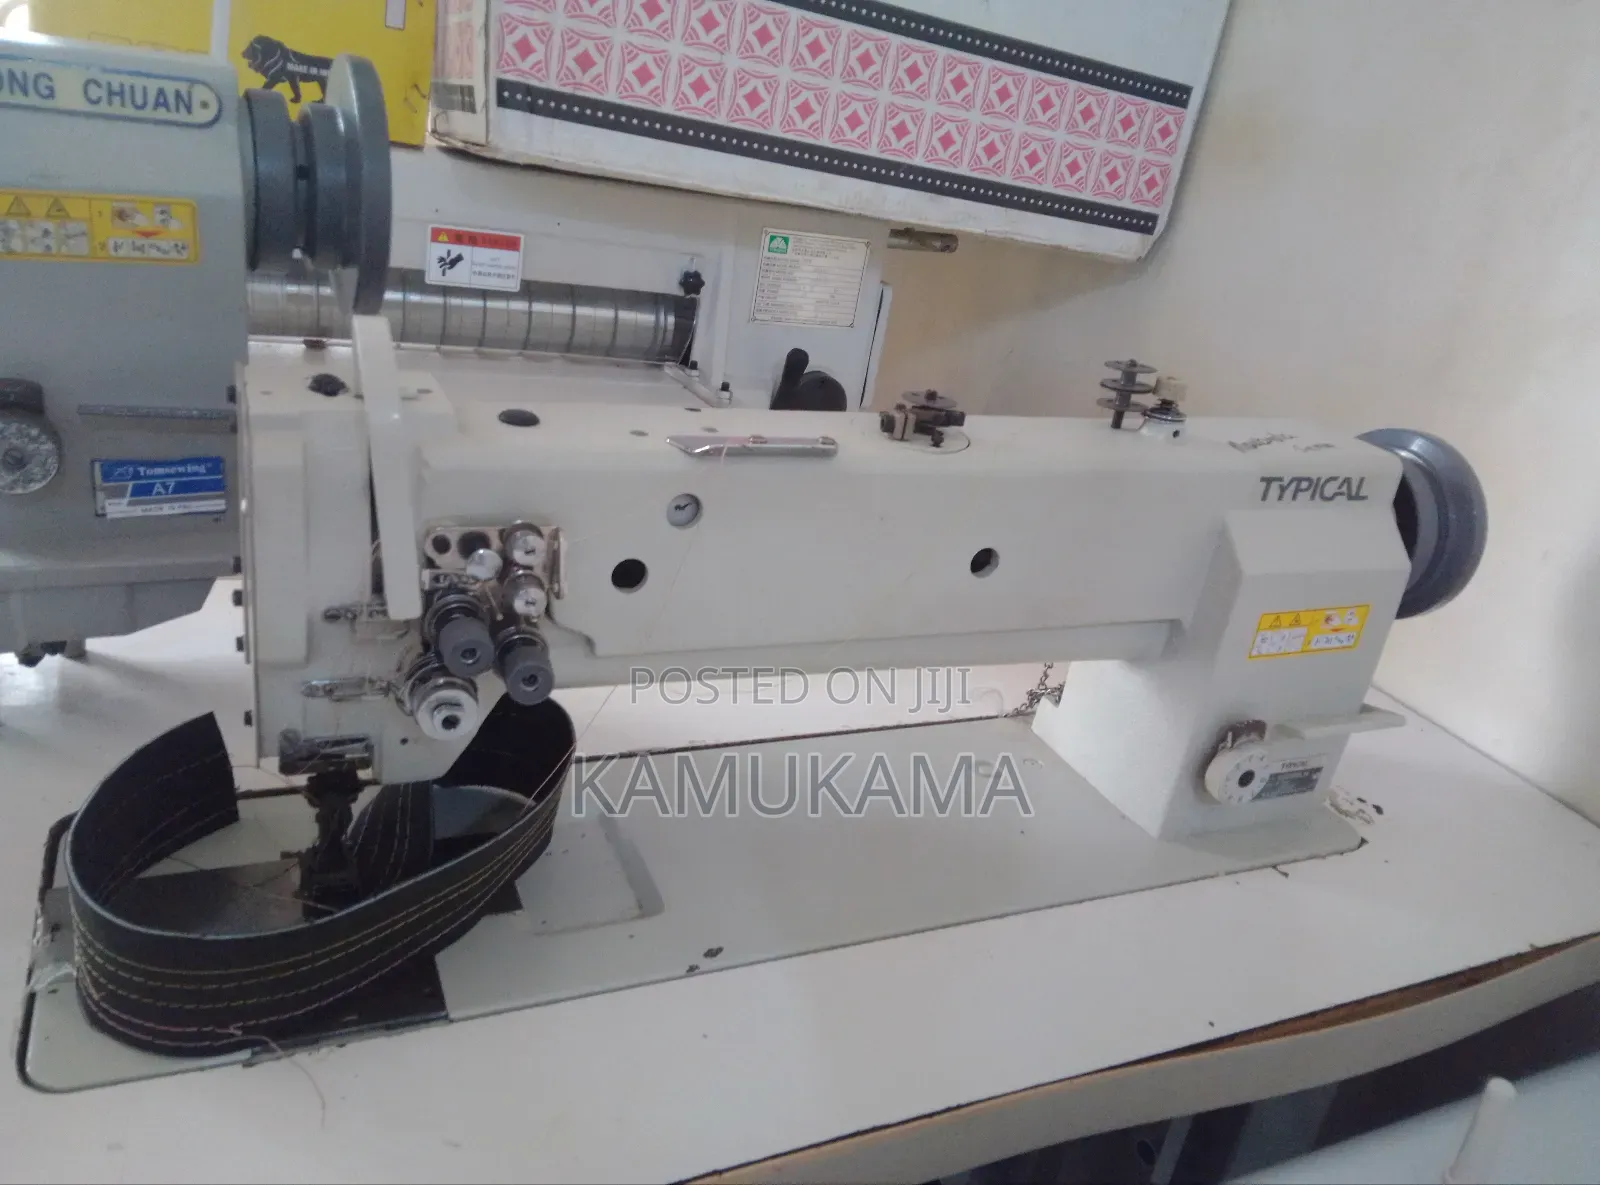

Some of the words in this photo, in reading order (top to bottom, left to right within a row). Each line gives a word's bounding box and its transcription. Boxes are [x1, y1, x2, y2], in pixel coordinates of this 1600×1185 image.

[0, 67, 55, 100] NG
[82, 78, 194, 115] CHUAN
[152, 481, 176, 496] A7
[1260, 476, 1369, 502] TYPICAL
